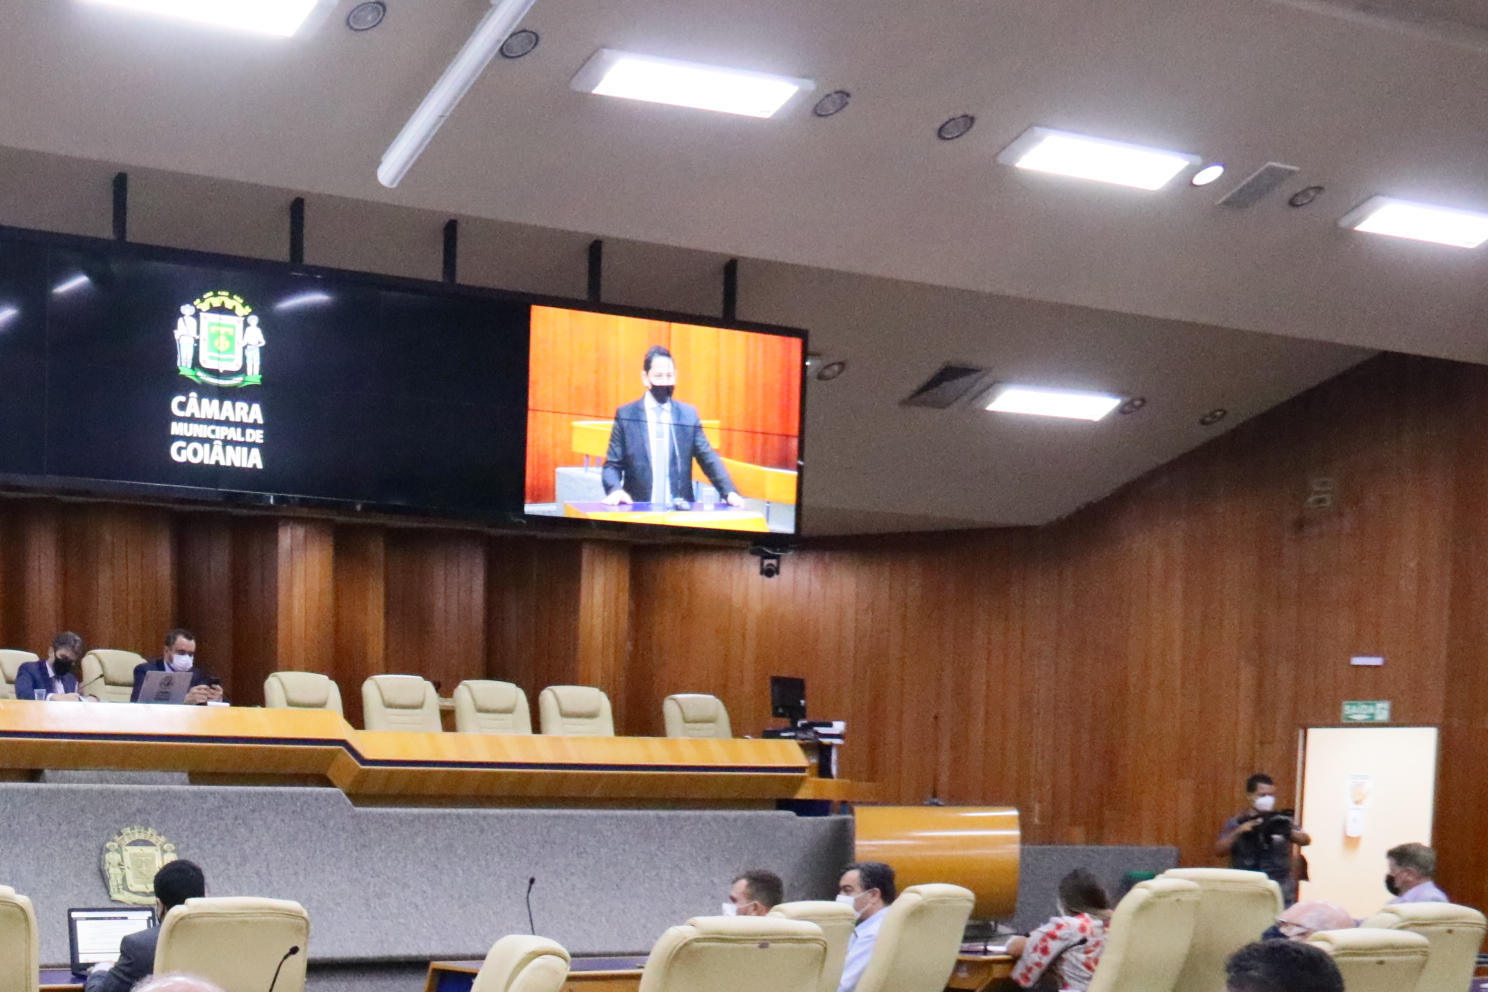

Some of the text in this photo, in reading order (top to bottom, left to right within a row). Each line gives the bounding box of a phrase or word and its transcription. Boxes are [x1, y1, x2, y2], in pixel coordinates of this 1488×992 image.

[171, 392, 263, 424] CÂMARA
[171, 422, 264, 443] MUNICIPAL DE
[170, 441, 263, 469] GOIÂNIA
